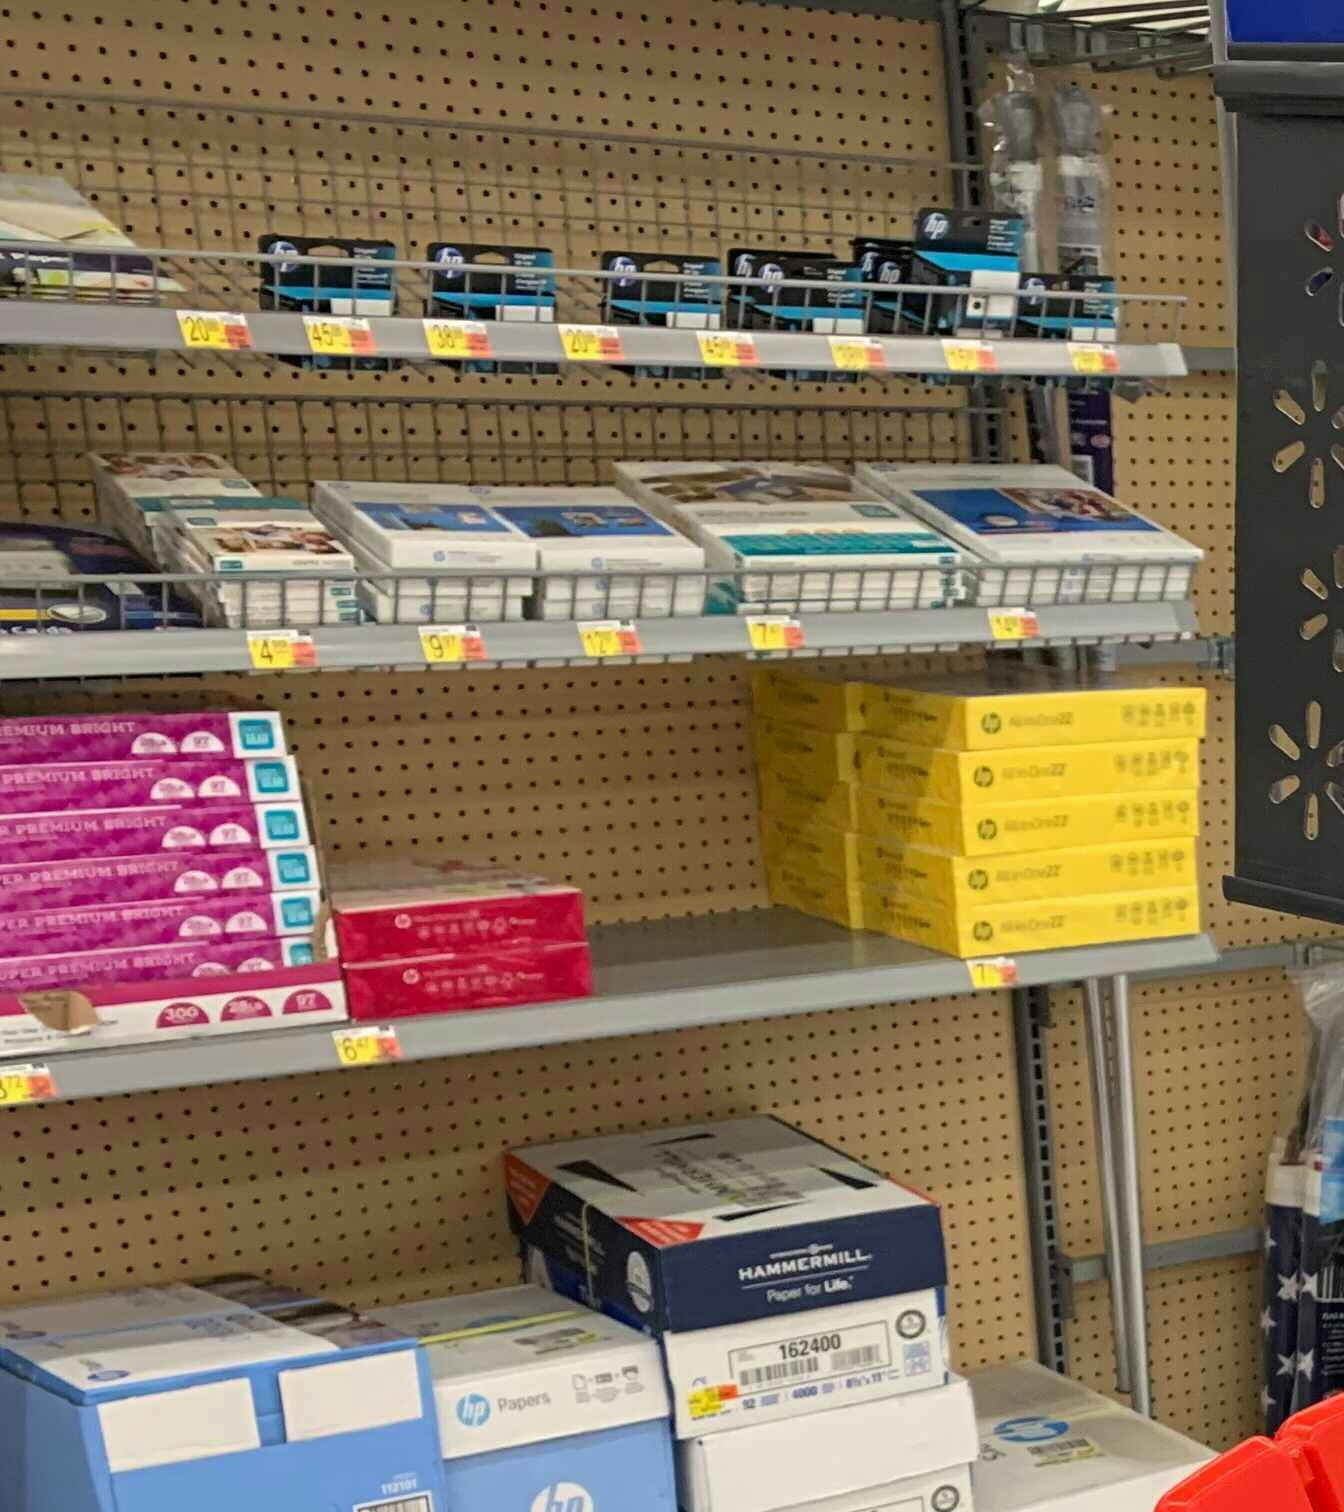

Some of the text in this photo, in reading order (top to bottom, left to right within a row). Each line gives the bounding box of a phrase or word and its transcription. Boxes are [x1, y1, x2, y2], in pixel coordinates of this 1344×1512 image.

[925, 212, 948, 241] hp
[70, 721, 137, 735] BRIGHT
[3, 770, 86, 785] PREMIUM
[16, 820, 98, 836] PREMIUM
[29, 866, 113, 884] PREMIUM
[35, 911, 117, 929] PREMIUM
[47, 957, 129, 977] PREMIUM
[738, 1247, 870, 1282] HAMMERMILL
[766, 1283, 802, 1303] Paper
[804, 1281, 823, 1298] for
[779, 1333, 842, 1361] 162400
[497, 1391, 552, 1413] Papers
